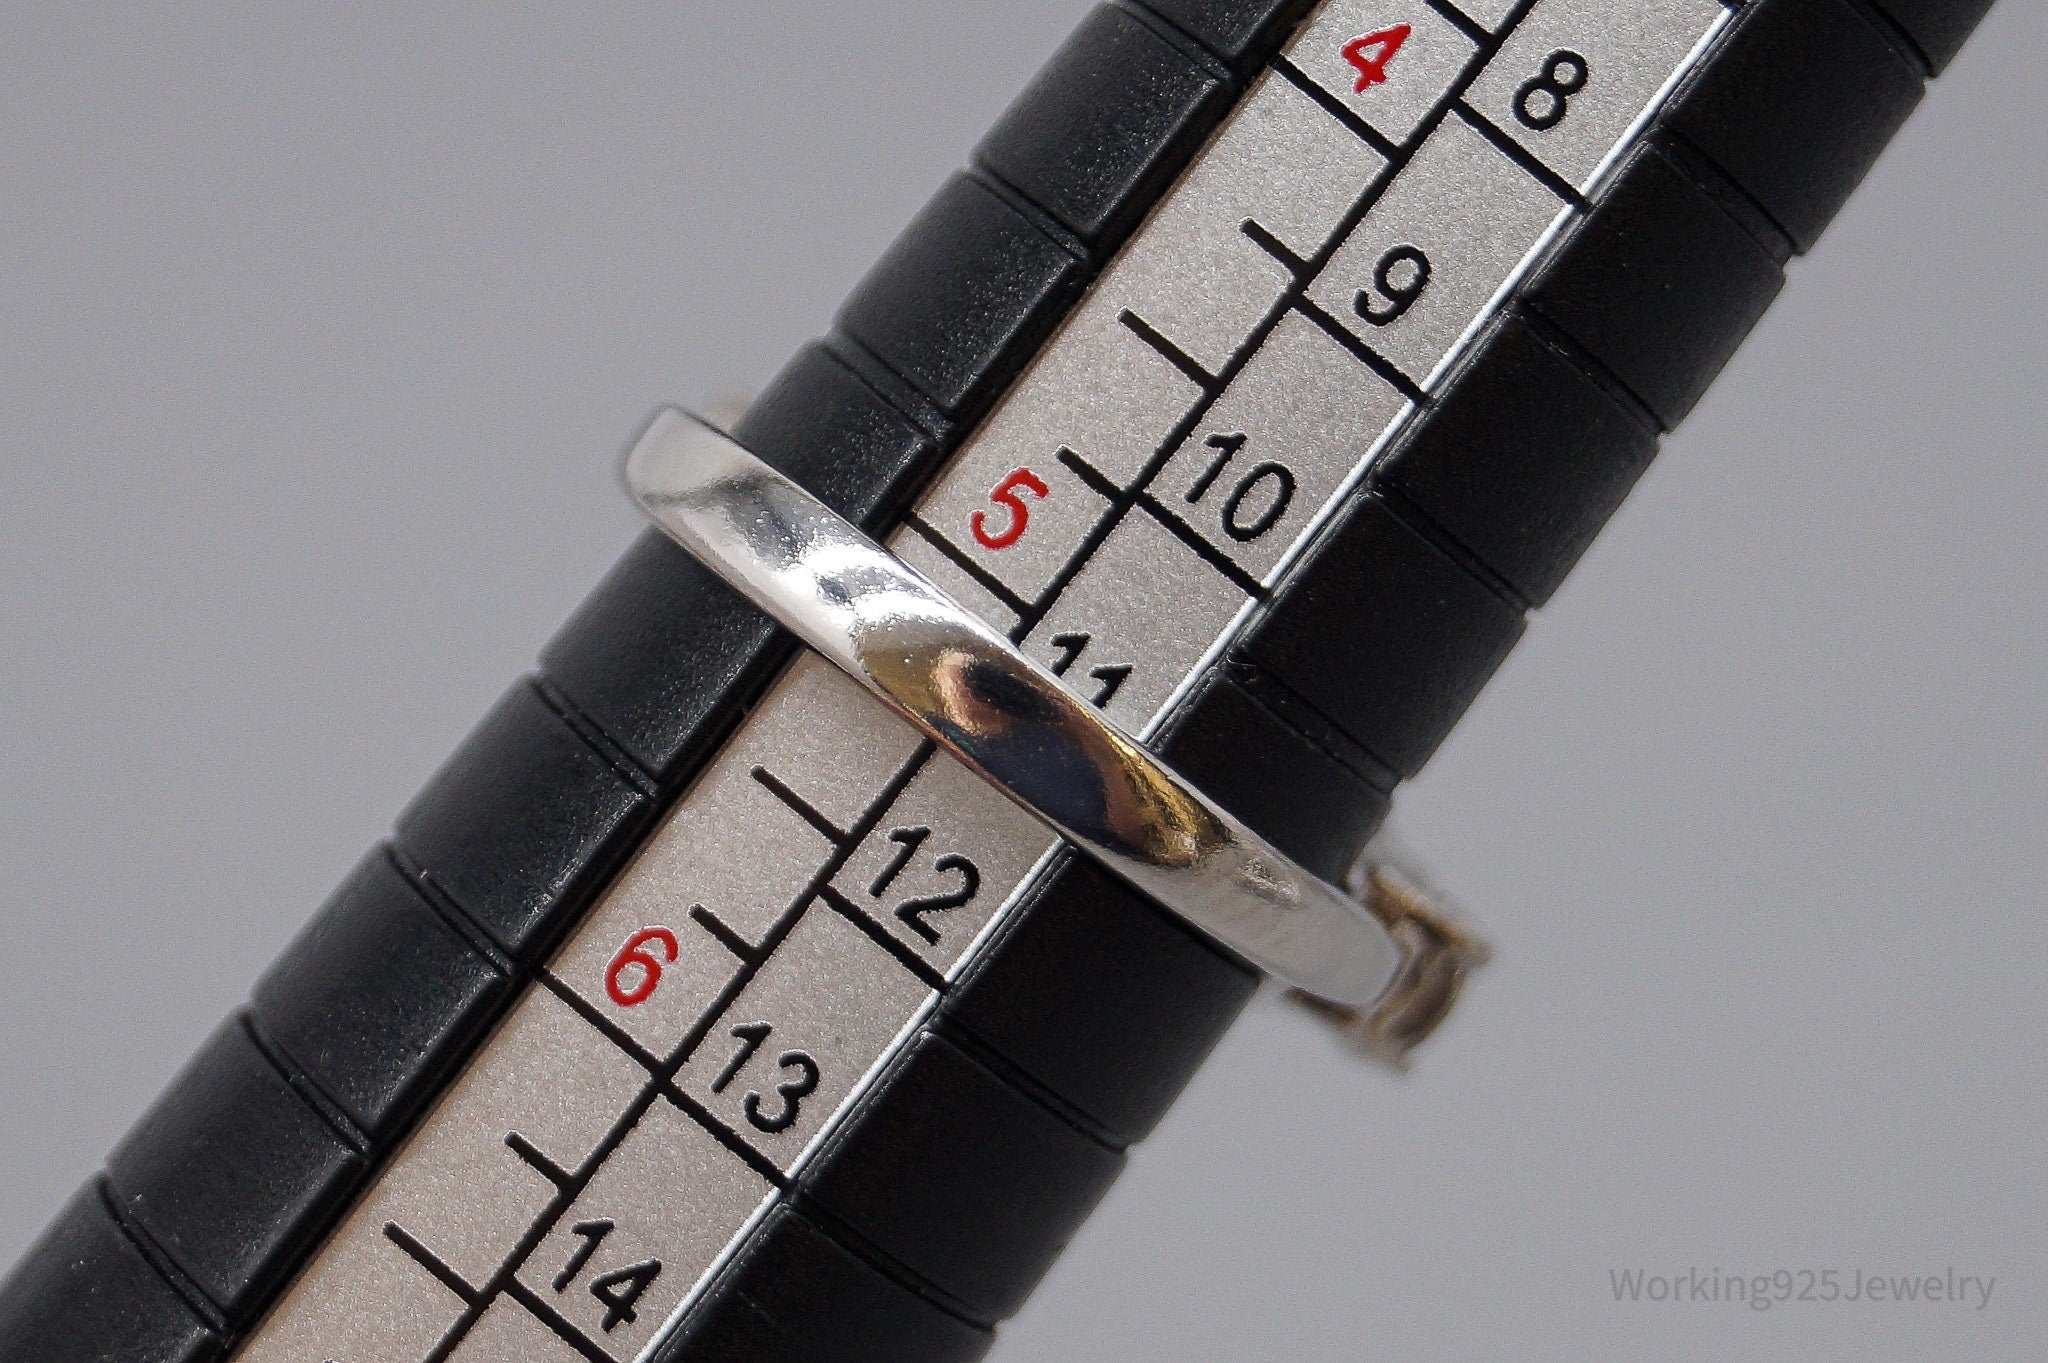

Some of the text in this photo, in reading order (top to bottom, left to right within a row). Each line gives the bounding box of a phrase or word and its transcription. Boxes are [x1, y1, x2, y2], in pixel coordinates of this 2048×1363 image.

[1340, 22, 1412, 93] 4
[1512, 49, 1589, 132] 8
[1353, 245, 1433, 327] 9
[969, 466, 1050, 550] 5
[1185, 432, 1297, 541] 10
[868, 825, 981, 945] 12
[604, 925, 680, 1007] 6
[710, 1021, 821, 1134] 13
[551, 1217, 662, 1332] 14
